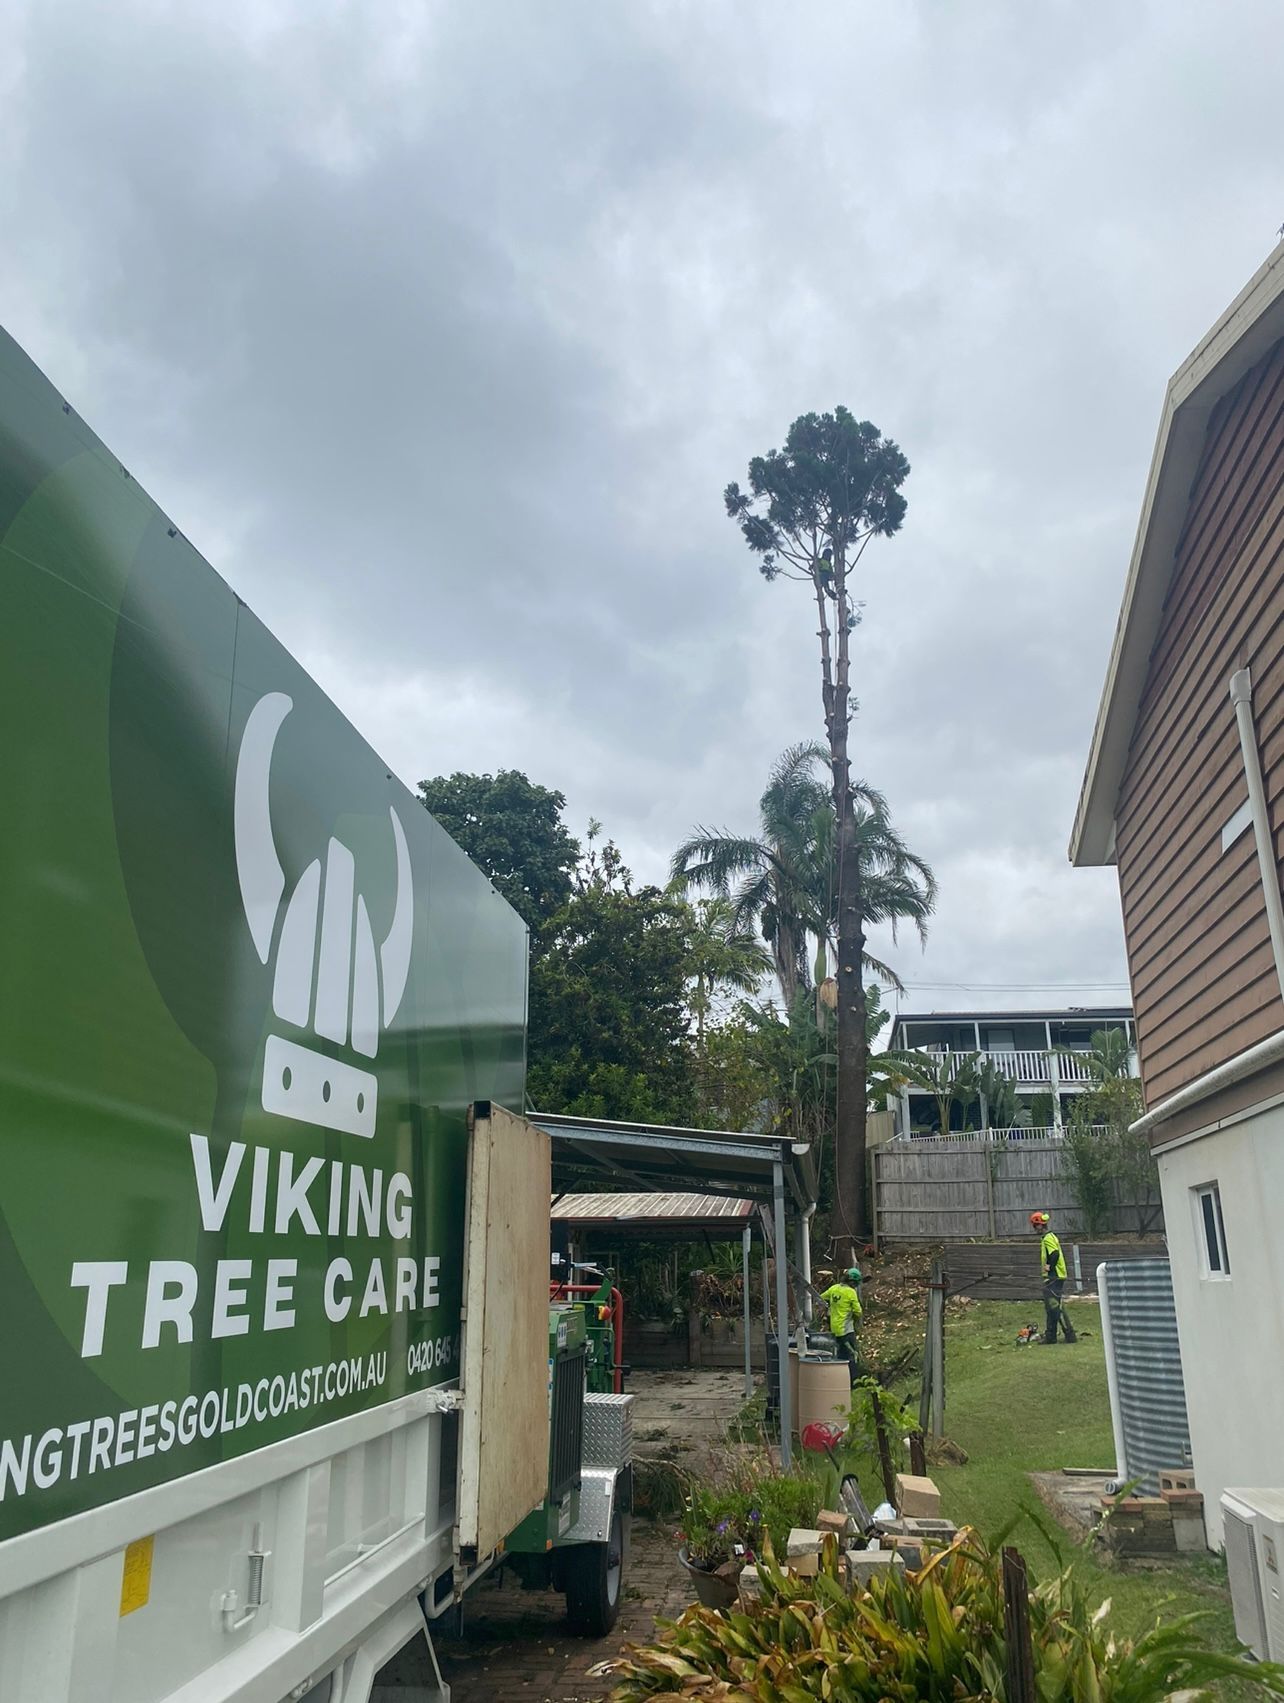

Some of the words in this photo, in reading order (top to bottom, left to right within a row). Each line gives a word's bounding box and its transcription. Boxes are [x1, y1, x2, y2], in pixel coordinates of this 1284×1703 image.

[190, 1133, 414, 1240] VIKING
[70, 1259, 298, 1359] TREE
[324, 1256, 441, 1323] CARE
[407, 1339, 434, 1376] 0420
